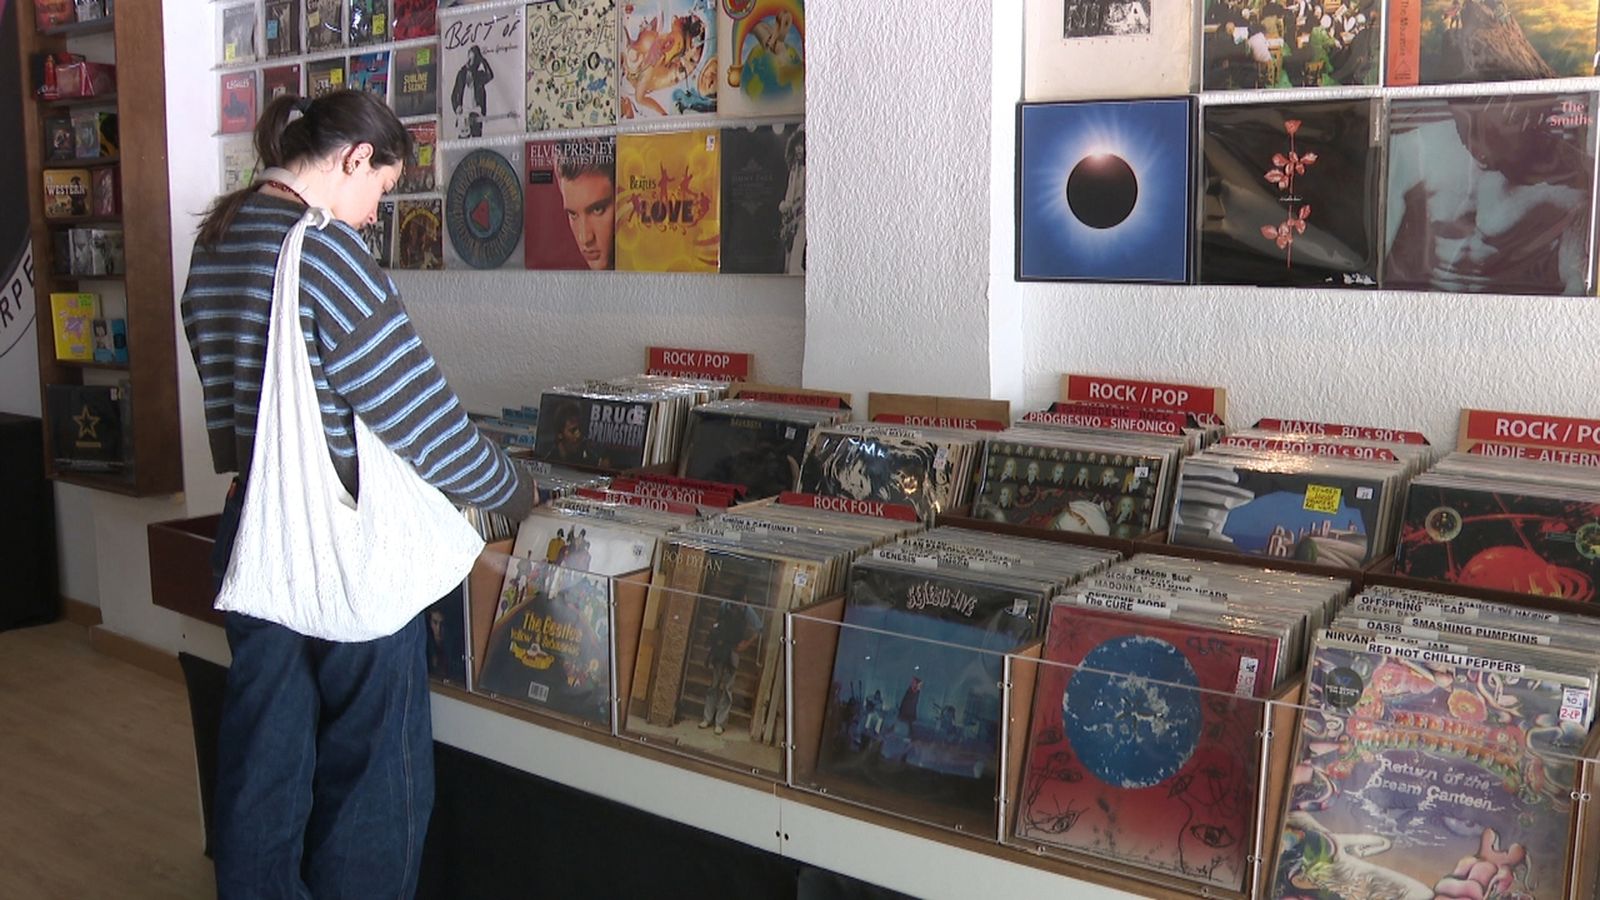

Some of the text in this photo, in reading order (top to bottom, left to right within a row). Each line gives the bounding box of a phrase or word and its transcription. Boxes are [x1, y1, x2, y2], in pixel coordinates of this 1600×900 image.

[445, 15, 520, 49] BEST OF
[1560, 101, 1584, 113] The
[1550, 113, 1593, 126] Smiths
[530, 141, 613, 158] ELVIS PRESLEY
[46, 184, 87, 195] WESTERN
[641, 200, 694, 223] LOVE
[663, 351, 695, 366] ROCK
[705, 354, 730, 368] POP
[1090, 382, 1139, 401] ROCK
[1152, 388, 1189, 406] POP
[591, 404, 646, 425] BRUC
[904, 416, 937, 427] ROCK
[1029, 412, 1101, 428] PROGRESIVO
[1110, 418, 1175, 434] SINFONICO
[589, 421, 644, 447] SPRINGSTEEN
[1279, 420, 1325, 436] MAXIS
[1495, 418, 1558, 441] ROCK
[1227, 438, 1269, 451] ROCK
[1284, 442, 1314, 455] POP
[1481, 443, 1526, 459] INDIE
[635, 485, 664, 500] ROCK
[641, 499, 668, 512] MOD
[814, 496, 884, 516] ROCK FOLK
[1094, 580, 1142, 593] MADONNA
[1106, 600, 1133, 611] CURE
[1362, 596, 1422, 612] OFFSPRING
[1367, 621, 1402, 635] OASIS
[1412, 618, 1538, 645] SMASHING PUMPKINS
[1368, 643, 1521, 673] RED HOT CHILLI PEPPERS
[1380, 757, 1438, 780] Return
[1369, 774, 1493, 811] Dream Canteen
